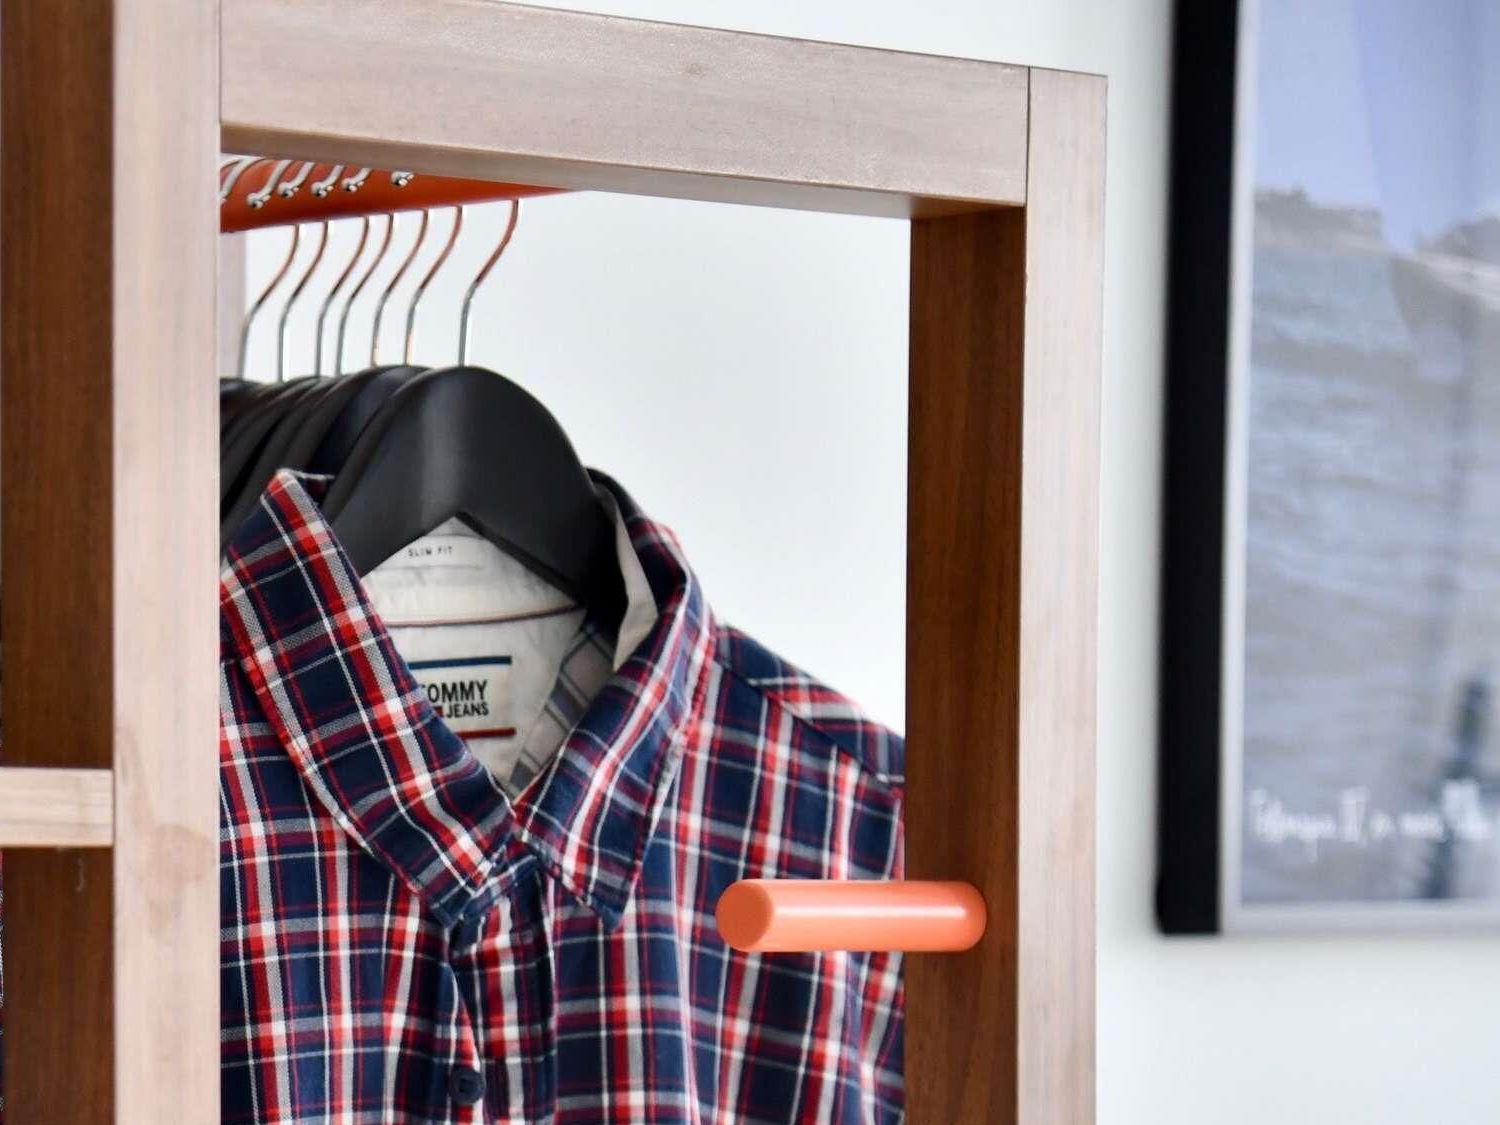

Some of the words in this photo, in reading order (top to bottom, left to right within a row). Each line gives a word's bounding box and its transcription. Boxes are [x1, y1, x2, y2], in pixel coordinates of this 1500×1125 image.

[408, 548, 432, 557] SLIM
[438, 546, 452, 554] FIT
[421, 679, 487, 703] OMMY
[446, 701, 489, 718] JEANS
